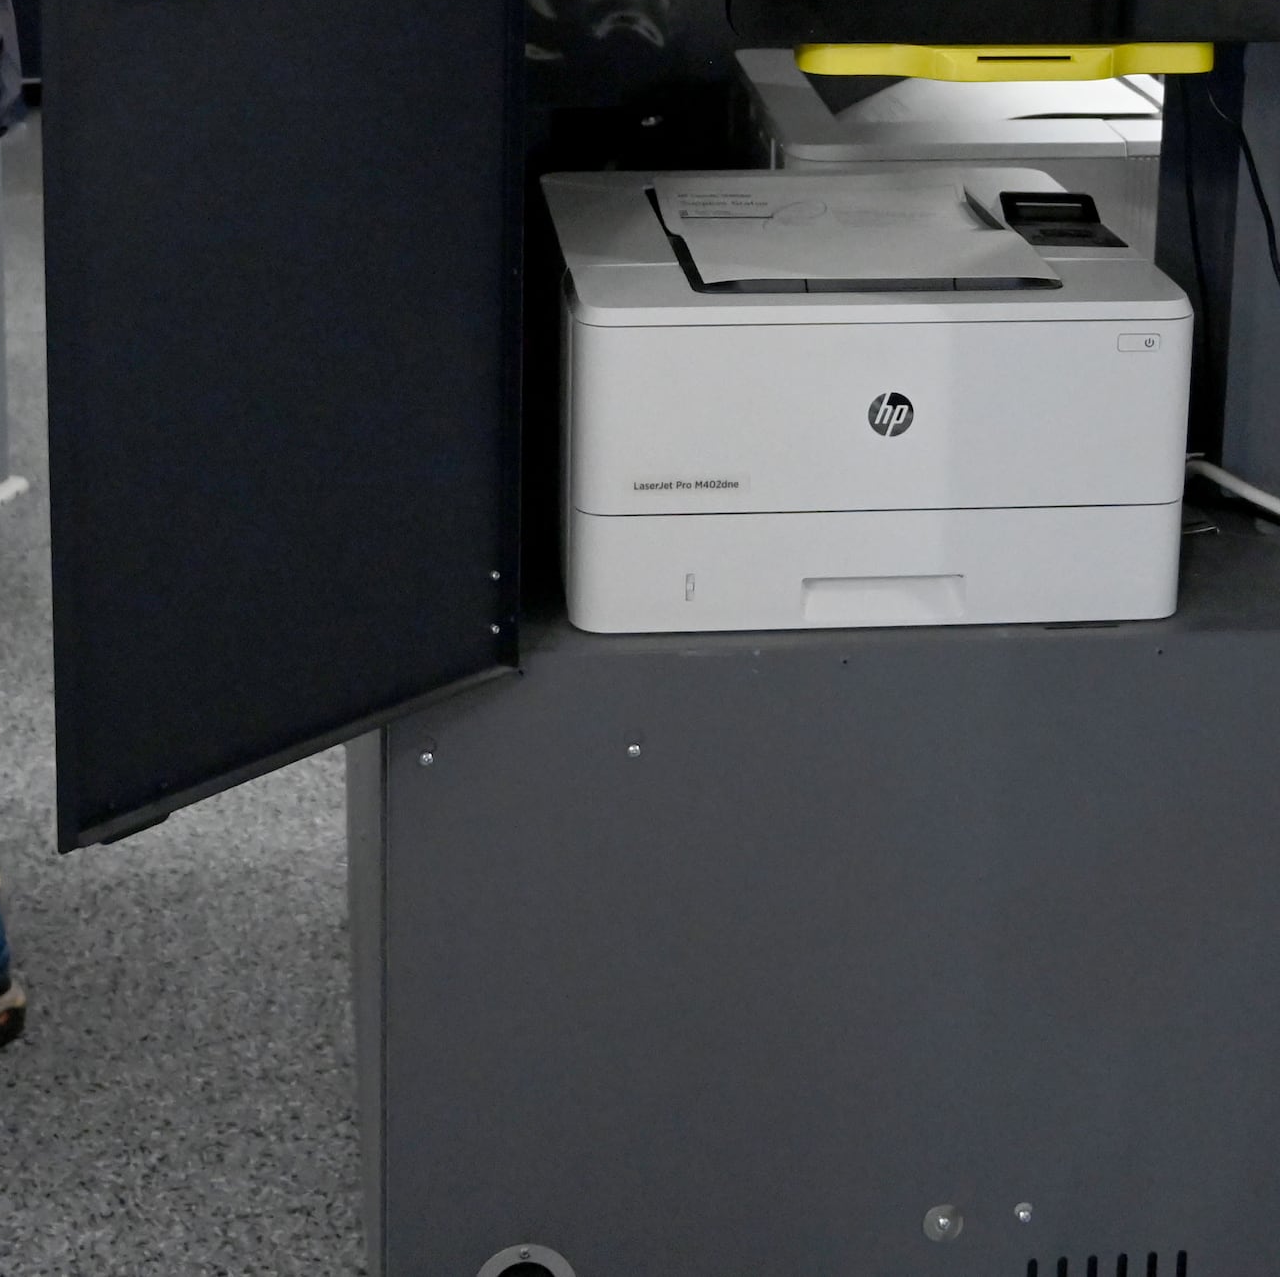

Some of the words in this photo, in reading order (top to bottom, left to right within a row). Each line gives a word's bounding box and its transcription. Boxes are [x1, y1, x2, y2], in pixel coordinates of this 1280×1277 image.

[871, 392, 911, 436] hp
[633, 481, 673, 491] LaserJet
[676, 481, 692, 490] Pro
[694, 480, 739, 489] M402dne
